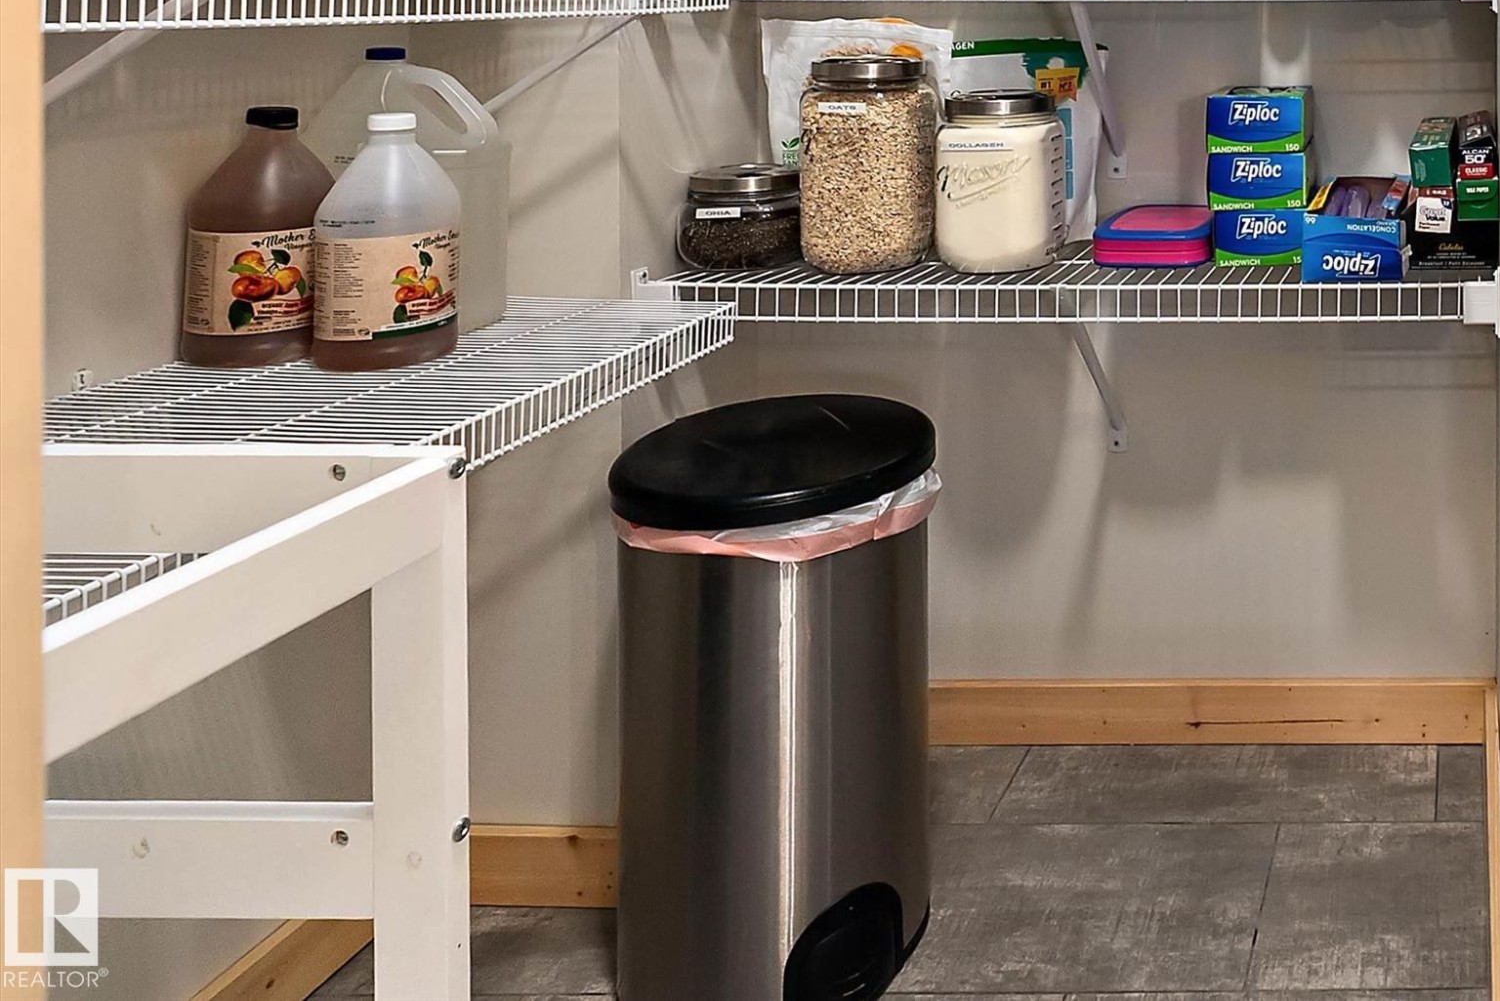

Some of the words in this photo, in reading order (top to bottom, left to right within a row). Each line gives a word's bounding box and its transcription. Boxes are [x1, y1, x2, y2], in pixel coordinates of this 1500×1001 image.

[951, 41, 975, 50] AGEN
[1233, 104, 1280, 125] Ziploc
[1285, 144, 1299, 152] 150
[1236, 161, 1282, 182] Ziploc
[1287, 200, 1301, 208] 150
[1425, 214, 1446, 222] Value
[1241, 217, 1287, 239] Ziploc
[262, 232, 305, 248] Mother
[1219, 259, 1261, 267] SANDWICH
[1322, 252, 1376, 276] Ziploc
